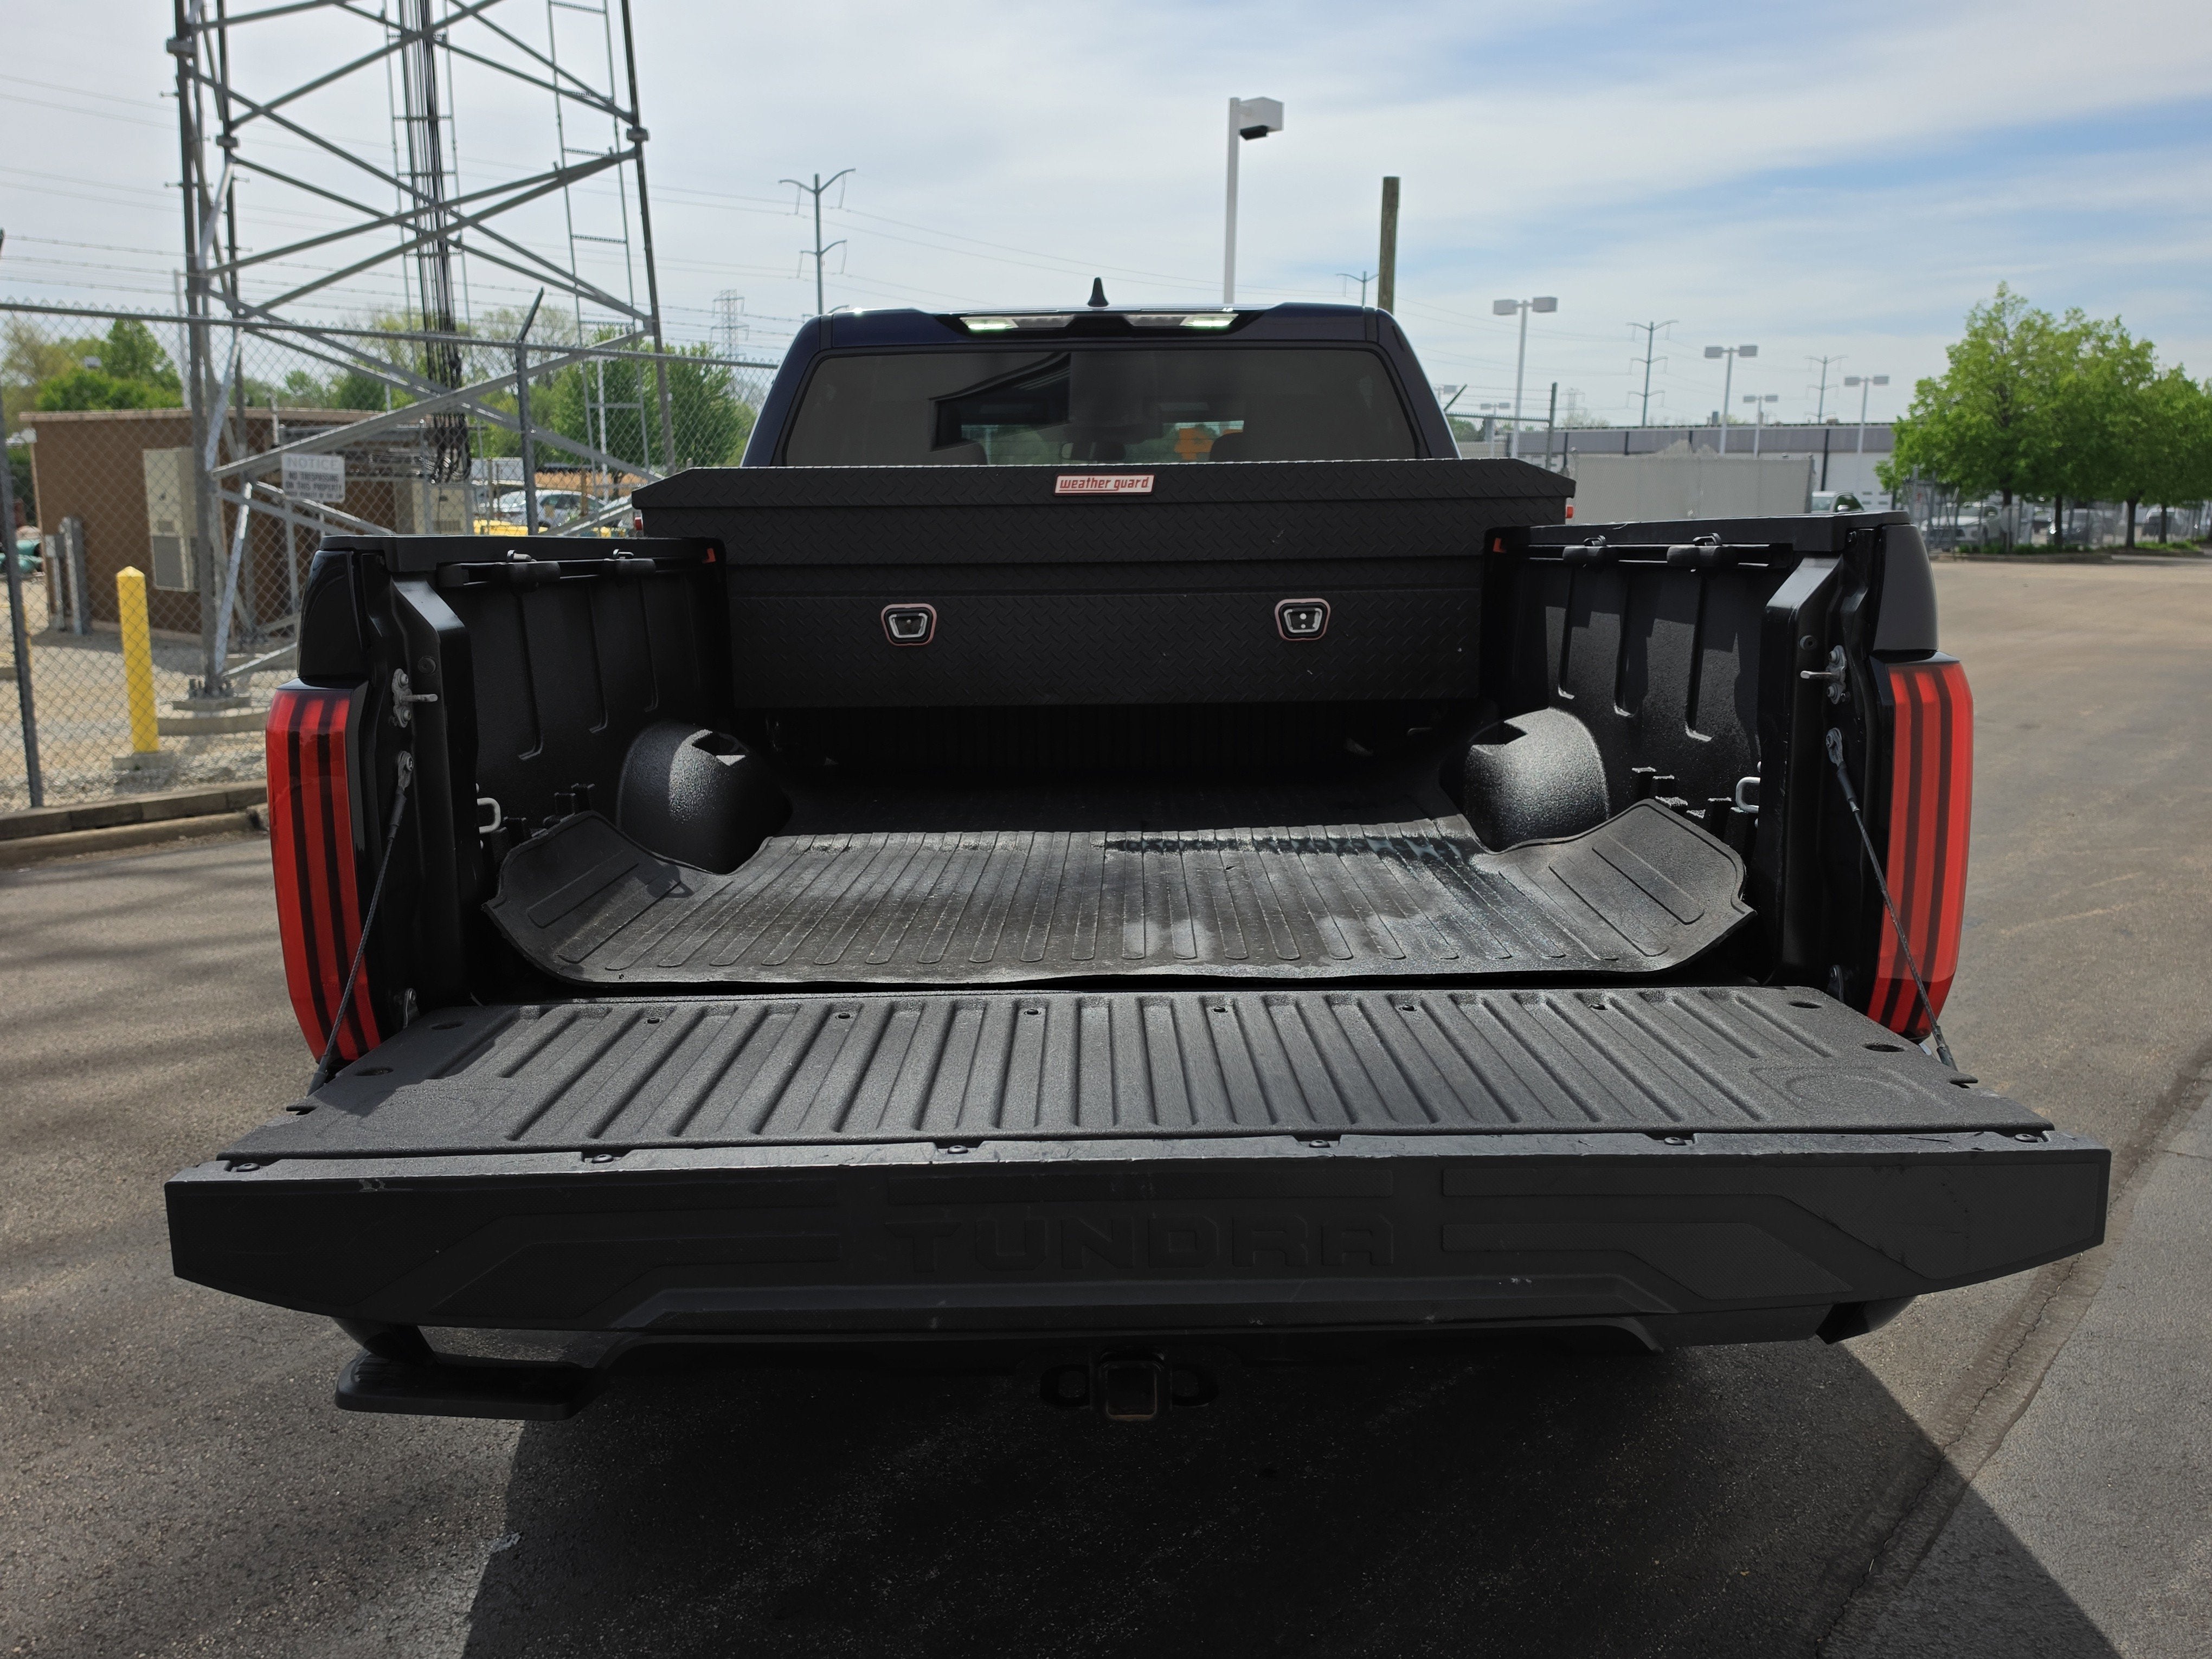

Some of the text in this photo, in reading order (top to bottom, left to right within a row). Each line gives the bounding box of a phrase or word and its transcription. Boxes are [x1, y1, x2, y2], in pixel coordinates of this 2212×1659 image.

[286, 456, 339, 470] NOTICE
[288, 471, 339, 483] NO TRESPASSING
[1060, 477, 1149, 491] weather guard
[285, 480, 294, 489] ON
[296, 481, 311, 491] THIS
[884, 1213, 1394, 1273] TUNDRA
